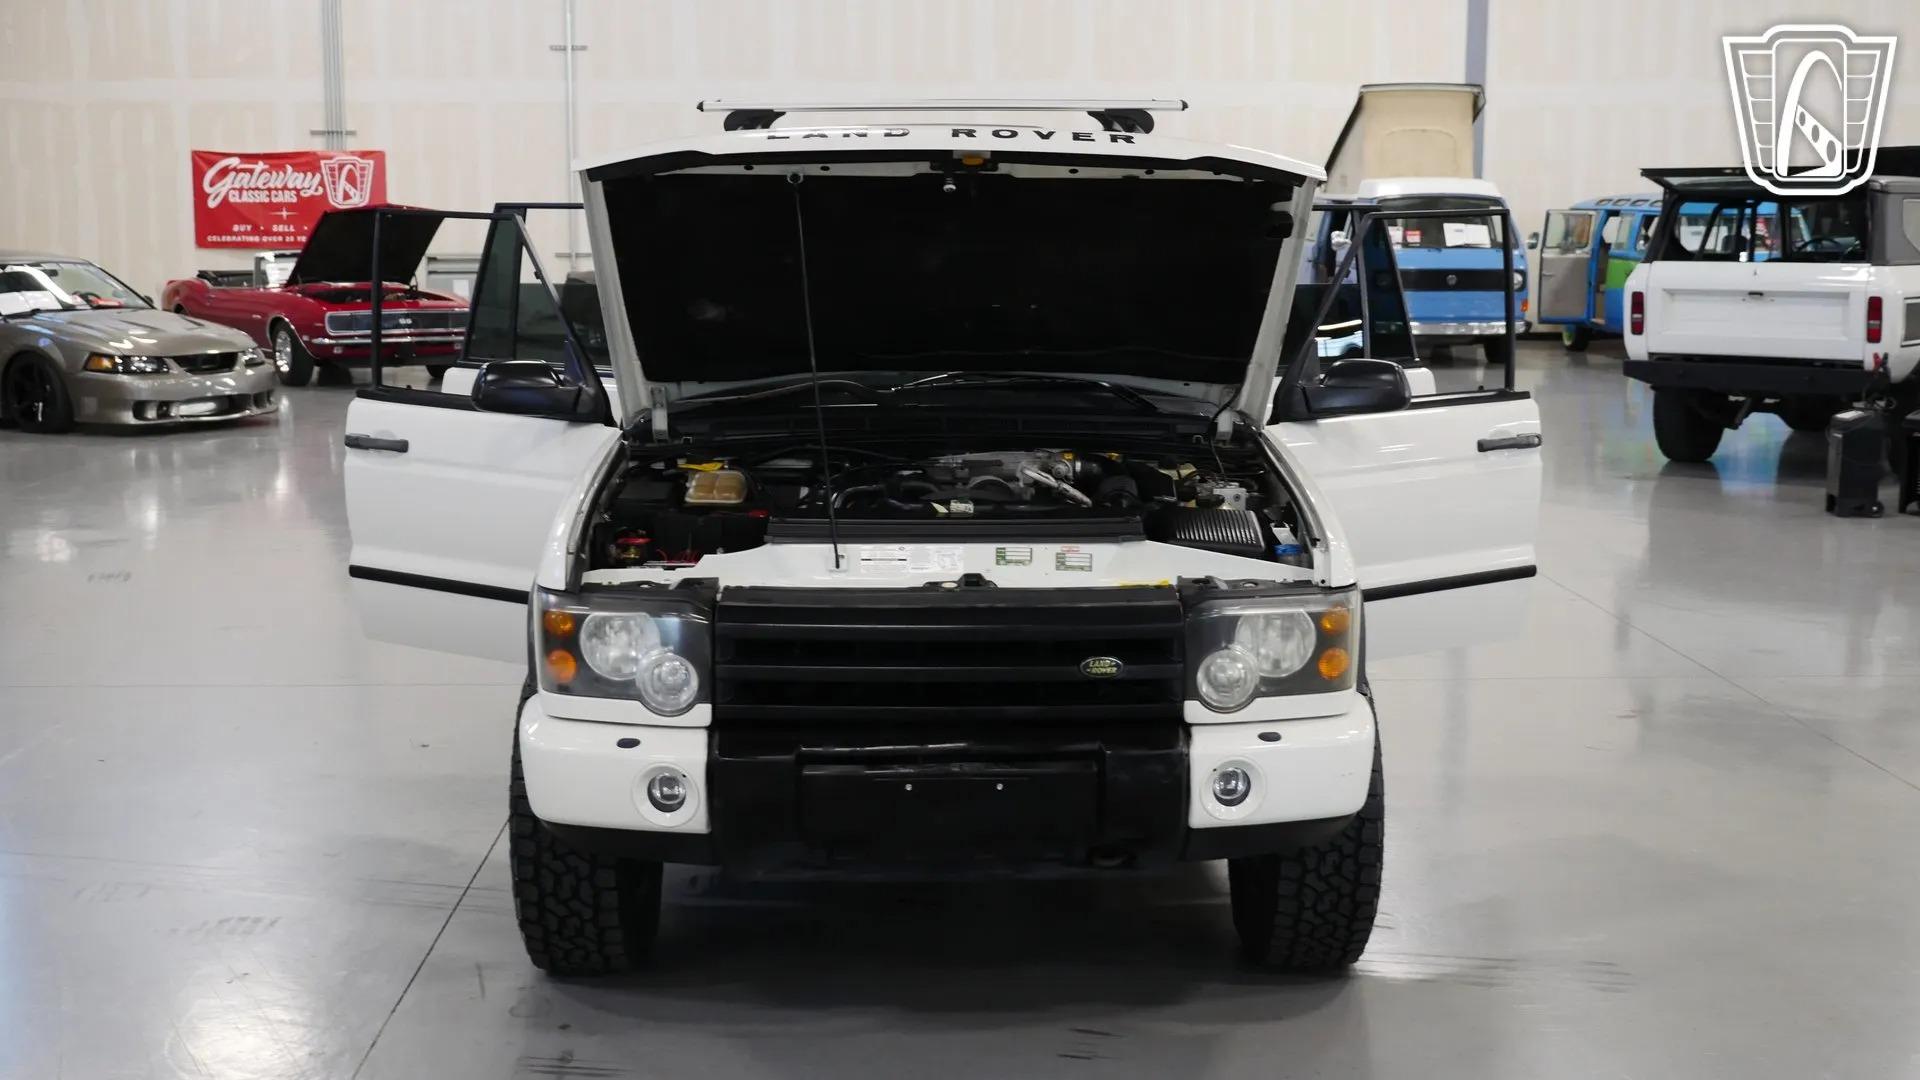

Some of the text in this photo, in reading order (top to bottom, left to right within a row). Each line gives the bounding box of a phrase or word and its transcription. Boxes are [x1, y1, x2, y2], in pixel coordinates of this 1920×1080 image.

[767, 128, 1136, 144] LAND ROVER
[203, 156, 323, 209] Gateway
[228, 189, 298, 203] CLASSIC CARS
[232, 224, 295, 232] BUY SELL
[206, 235, 260, 243] CELEBRATING
[262, 235, 283, 243] OVER
